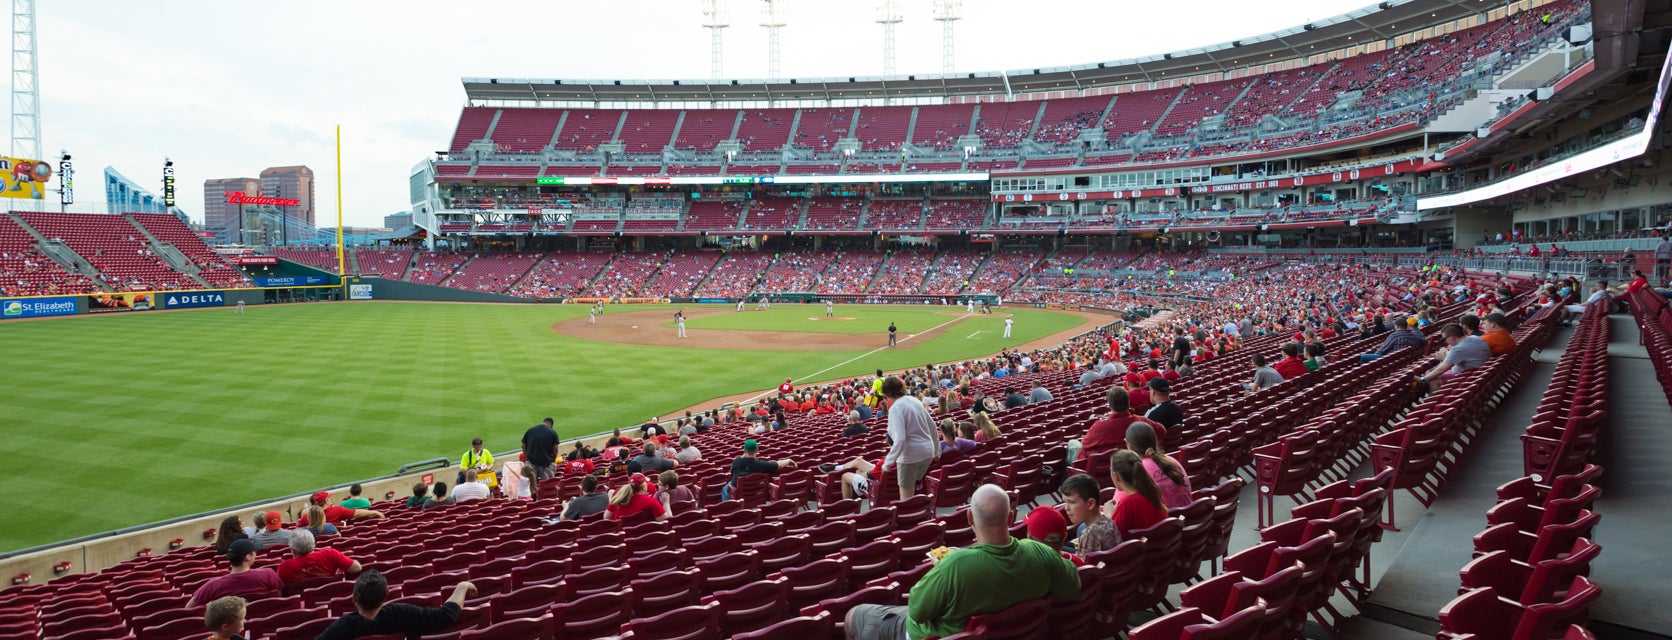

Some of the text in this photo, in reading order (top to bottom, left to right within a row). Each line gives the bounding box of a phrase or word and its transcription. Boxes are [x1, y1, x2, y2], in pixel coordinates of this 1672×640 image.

[1213, 184, 1239, 192] CINCINNATI
[1239, 182, 1252, 190] REDS
[224, 189, 299, 206] Budweiser
[182, 295, 223, 304] DELTA
[35, 301, 74, 311] Elizabeth
